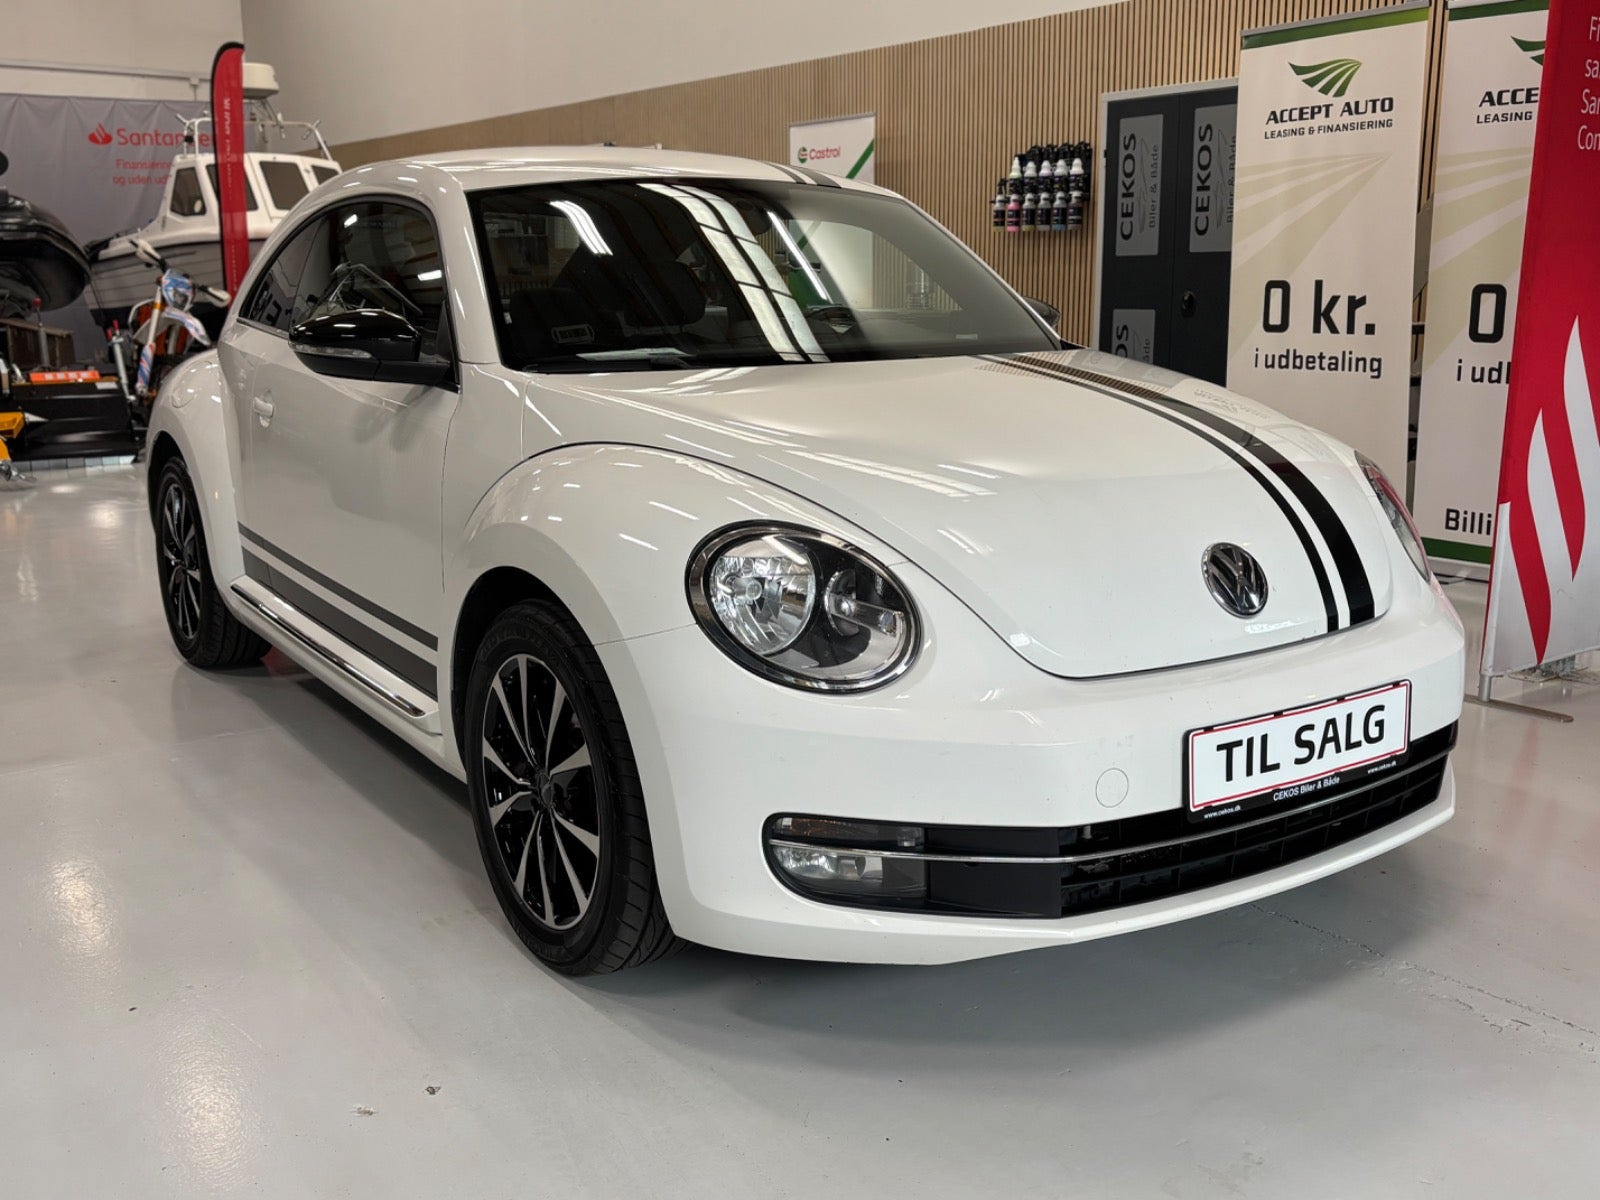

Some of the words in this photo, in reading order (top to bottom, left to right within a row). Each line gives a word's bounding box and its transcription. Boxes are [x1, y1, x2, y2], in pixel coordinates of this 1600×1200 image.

[1265, 104, 1334, 125] ACCEPT
[1339, 97, 1394, 117] AUTO
[1479, 87, 1539, 107] ACCE
[1264, 127, 1305, 140] LEASING
[1308, 126, 1315, 135] &
[1317, 118, 1393, 134] FINANSIERING
[1476, 111, 1533, 124] LEASING
[809, 146, 841, 160] Castrol
[1120, 132, 1137, 241] CEKOS
[1194, 123, 1213, 237] CEKOS
[1148, 199, 1158, 228] Biler
[1263, 280, 1291, 333] 0
[1312, 279, 1376, 335] kr.
[1254, 347, 1259, 368] i
[1264, 348, 1382, 379] udbetaling
[1456, 358, 1462, 382] i
[1445, 507, 1492, 536] Billi
[1216, 733, 1281, 782] TIL
[1293, 704, 1385, 765] SALG
[1273, 787, 1300, 802] CEKOS
[1300, 783, 1316, 794] Biler
[1316, 781, 1323, 790] &
[1203, 804, 1241, 819] www.cekos.dk
